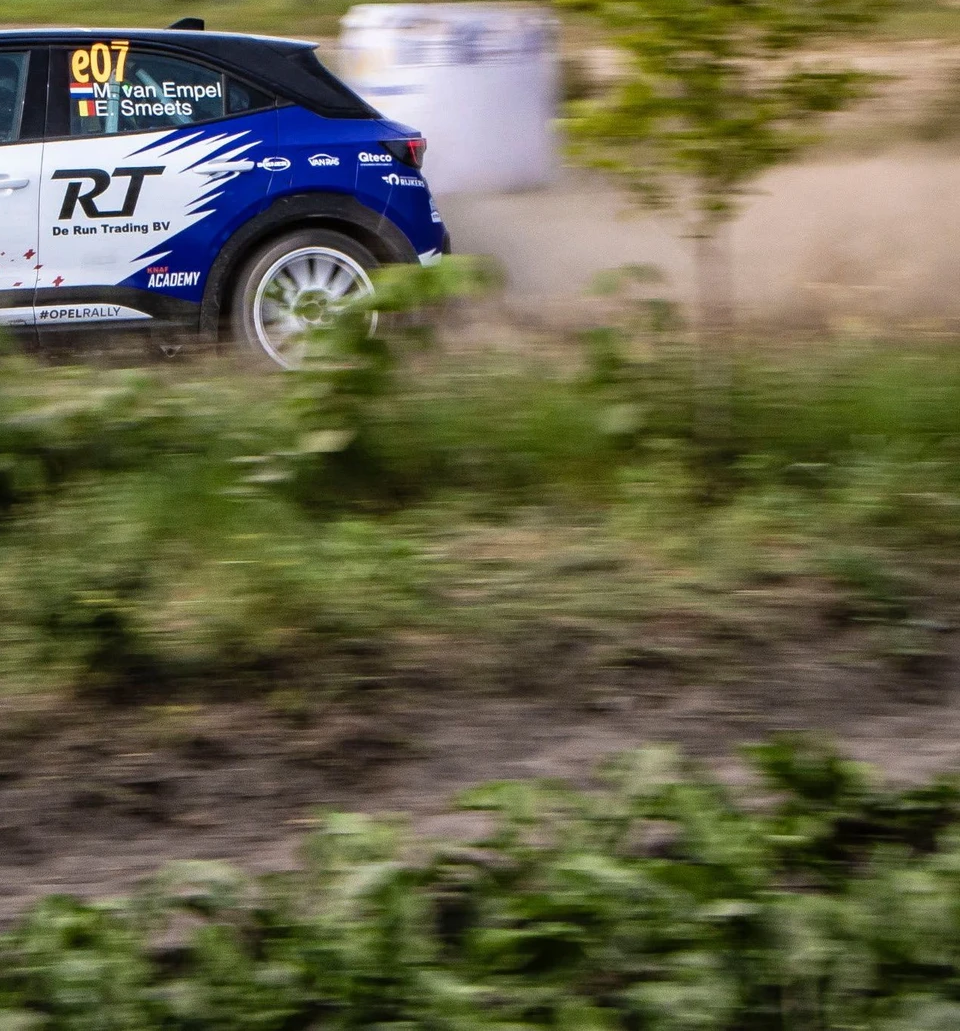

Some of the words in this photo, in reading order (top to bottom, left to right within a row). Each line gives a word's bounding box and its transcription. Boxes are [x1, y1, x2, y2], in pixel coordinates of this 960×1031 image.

[71, 40, 130, 83] e07
[93, 83, 117, 98] M.
[123, 85, 156, 98] van
[162, 82, 222, 104] Empel
[95, 101, 114, 116] E.
[121, 99, 192, 116] Smeets
[358, 152, 393, 163] Qteco
[51, 166, 166, 220] RT
[52, 226, 69, 236] De
[73, 225, 97, 235] Run
[101, 223, 149, 236] Trading
[153, 221, 171, 232] BV
[148, 272, 201, 288] ACADEMY
[39, 306, 121, 319] #OPELRALLY
